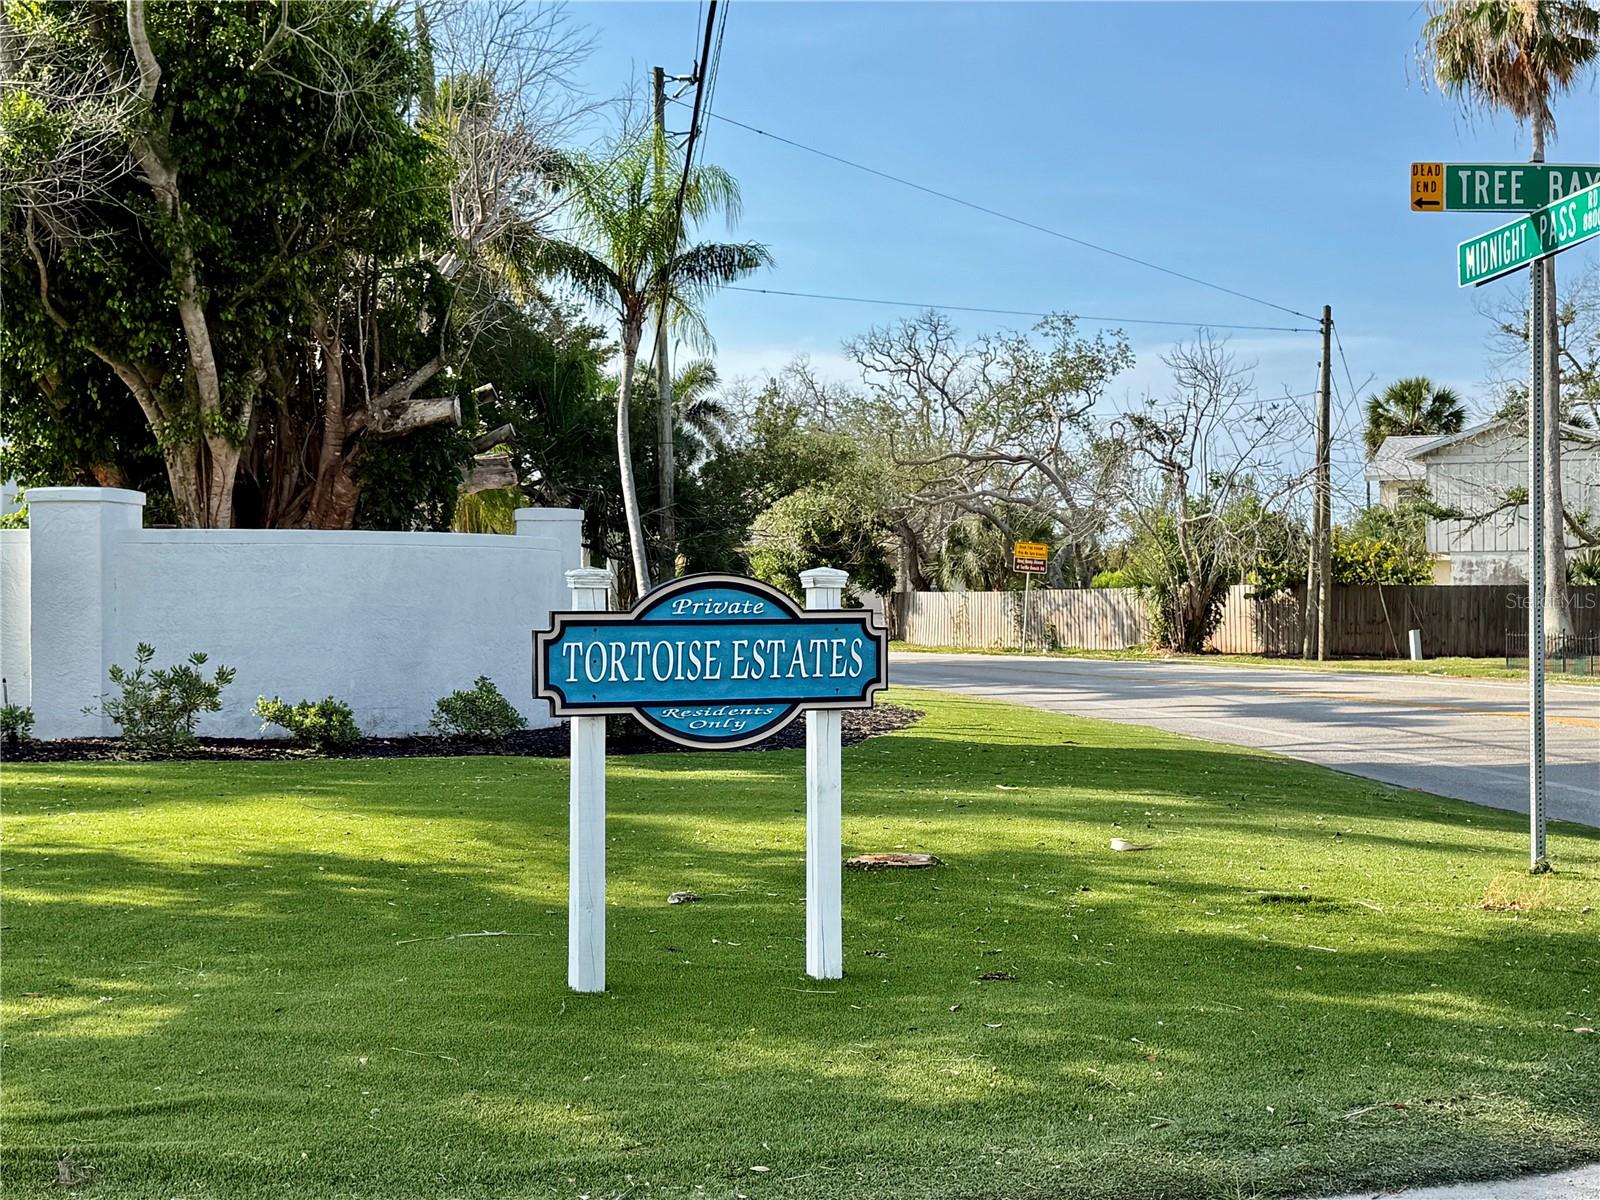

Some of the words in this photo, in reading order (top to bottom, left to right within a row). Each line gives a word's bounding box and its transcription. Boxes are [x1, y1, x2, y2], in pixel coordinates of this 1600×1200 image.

[1413, 165, 1441, 176] DEAD
[1416, 181, 1437, 193] END
[1458, 170, 1524, 205] TREE
[1588, 189, 1598, 209] RD
[1466, 224, 1527, 279] MIDNIGHT
[1539, 202, 1577, 250] PASS
[672, 598, 764, 615] Private
[562, 640, 721, 683] TORTOISE
[732, 638, 863, 680] ESTATES
[661, 706, 774, 719] Residents
[689, 717, 746, 732] Only
